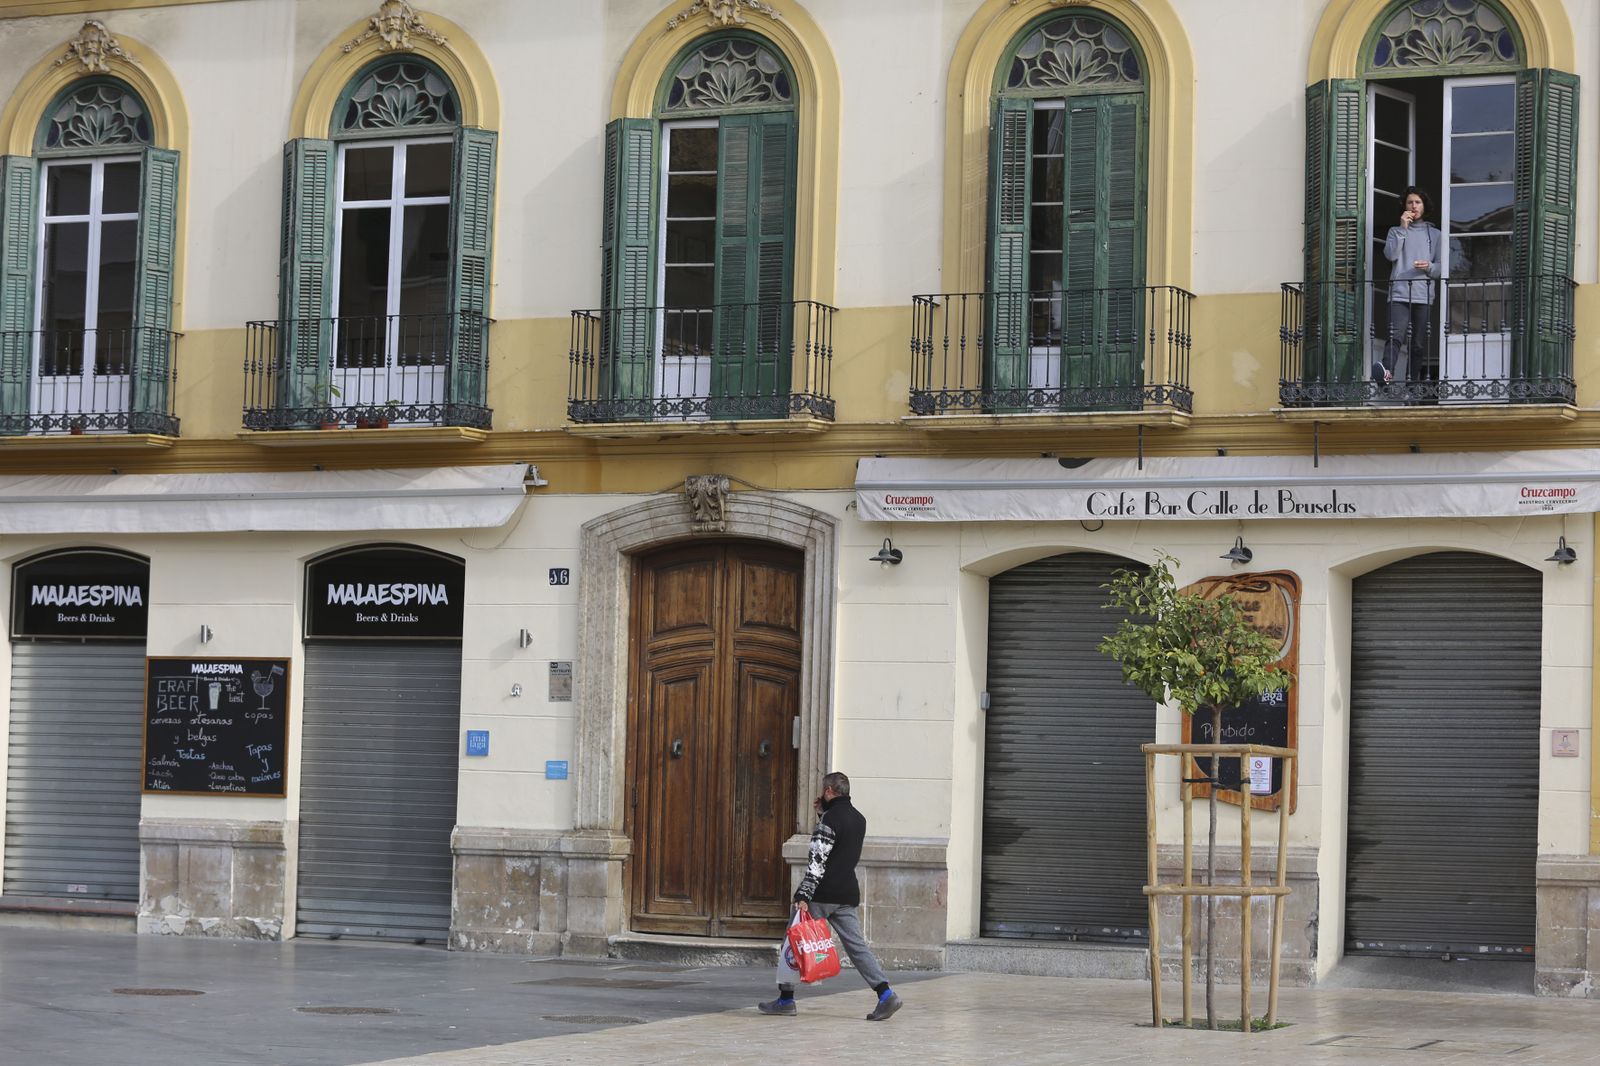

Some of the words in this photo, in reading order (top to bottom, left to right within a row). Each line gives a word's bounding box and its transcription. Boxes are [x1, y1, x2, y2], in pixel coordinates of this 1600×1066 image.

[1521, 487, 1576, 498] Cruzcampo
[885, 494, 934, 506] Cruzcampo
[1086, 491, 1136, 516] Café
[1144, 491, 1181, 516] Bar
[1186, 490, 1239, 515] Calle
[1247, 489, 1269, 514] de
[1277, 489, 1357, 514] Bruselas
[31, 585, 143, 606] MALAESPINA
[327, 583, 449, 606] MALAESPINA
[57, 613, 79, 622] Beers
[80, 613, 87, 622] &
[89, 613, 115, 623] Drinks
[356, 613, 379, 622] Beers
[380, 613, 388, 622] &
[390, 613, 419, 623] Drinks
[191, 663, 243, 674] MALAESPINA
[157, 695, 199, 713] BEER
[245, 713, 273, 725] copas
[187, 727, 217, 747] belgas
[176, 749, 206, 760] Tostas
[245, 744, 273, 759] Tapas
